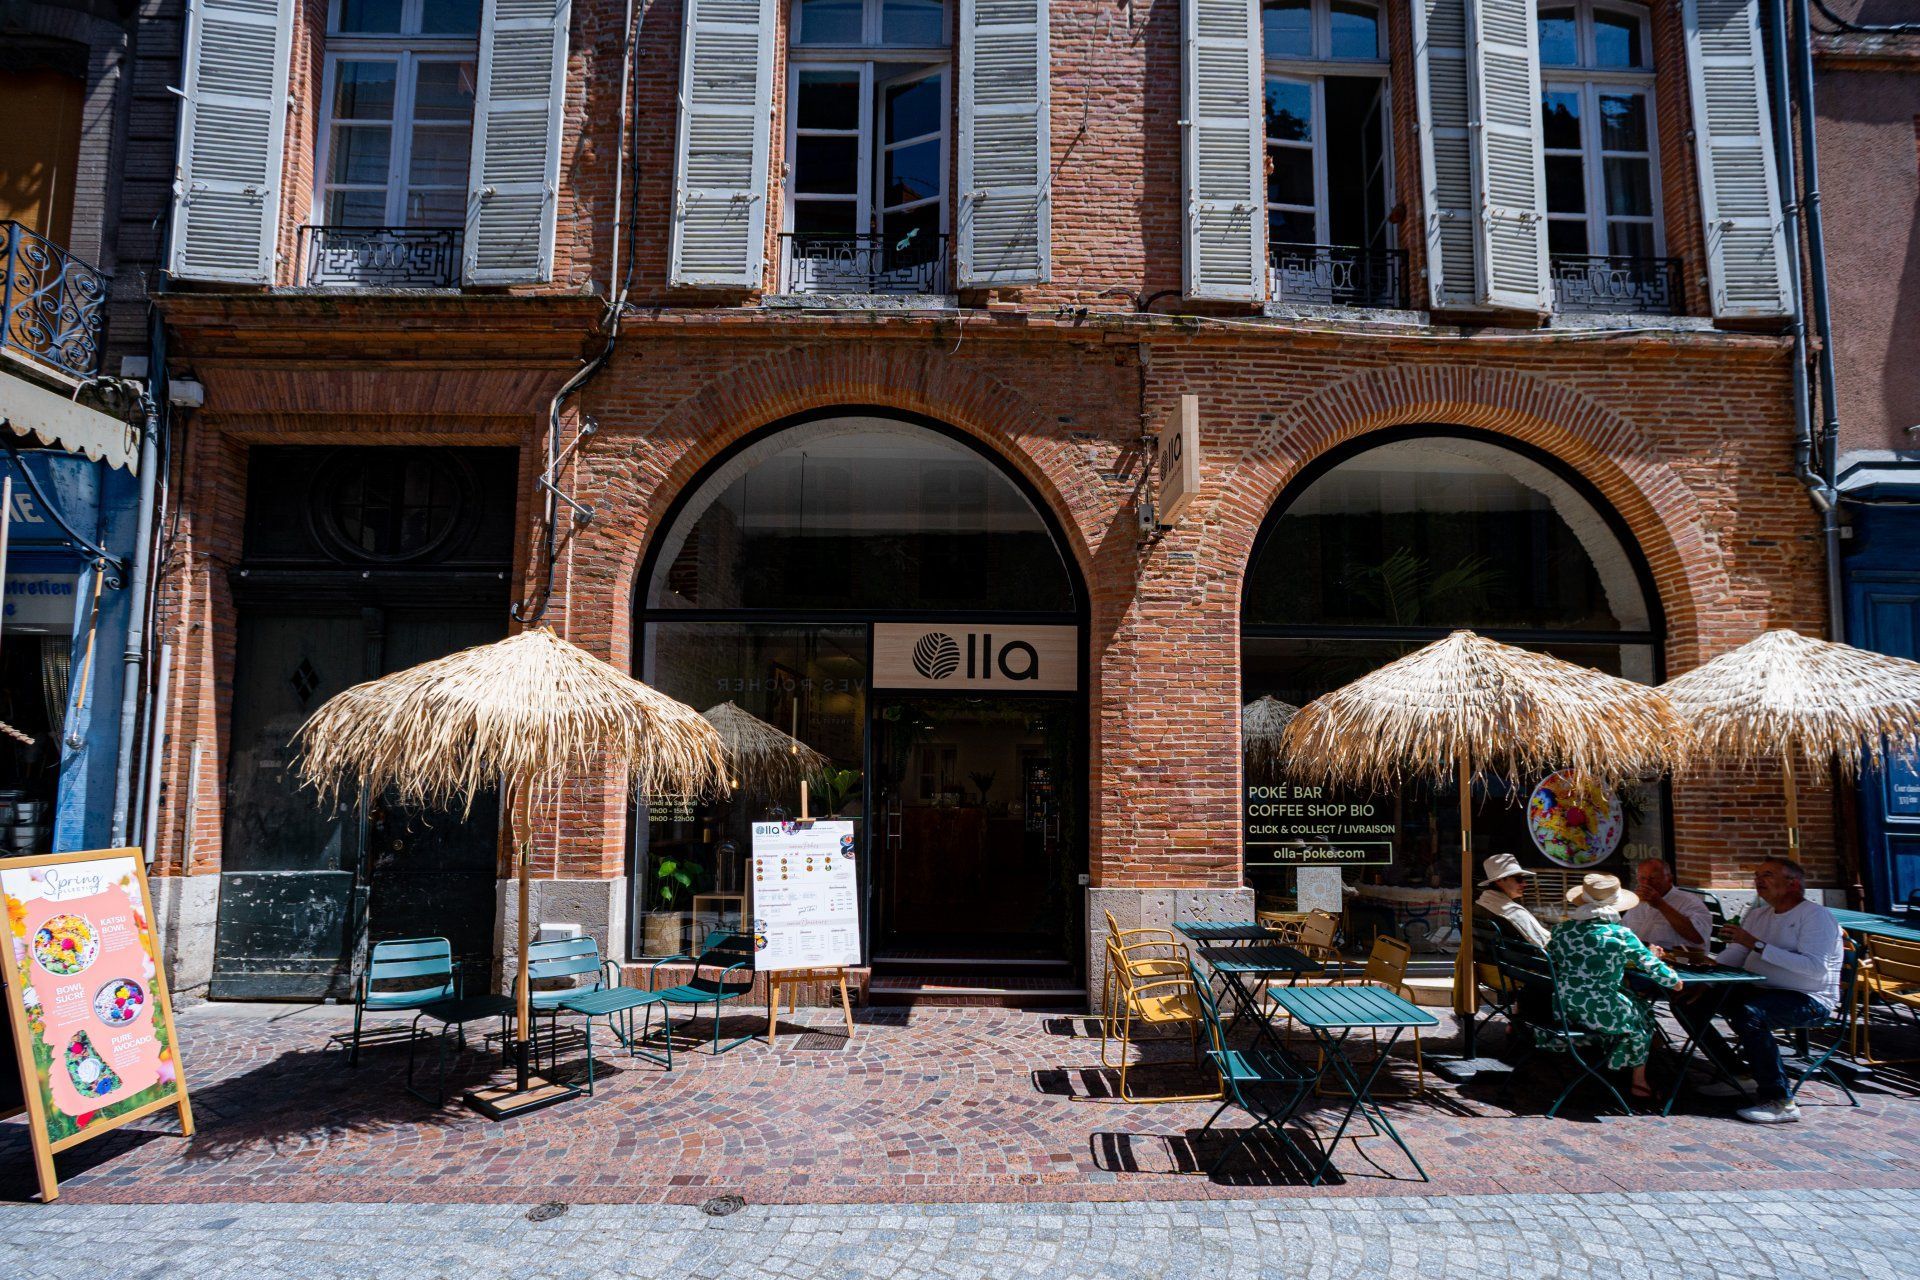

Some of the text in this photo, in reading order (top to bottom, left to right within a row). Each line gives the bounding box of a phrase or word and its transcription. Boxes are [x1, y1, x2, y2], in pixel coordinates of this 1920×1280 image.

[1249, 781, 1322, 799] POKÉ BAR
[1248, 804, 1375, 817] COFFEE SHOP BIO
[1249, 825, 1279, 834] CLICK
[1281, 825, 1289, 834] &
[1291, 825, 1336, 834] COLLECT
[1344, 824, 1396, 834] LIVRAISON
[1274, 847, 1365, 861] olla-poke.com
[44, 869, 103, 900] Spring
[100, 916, 127, 926] KATSU
[101, 925, 127, 934] BOWL
[56, 983, 83, 995] BOWL
[111, 1033, 133, 1045] PURE
[113, 1035, 152, 1053] AVOCADO
